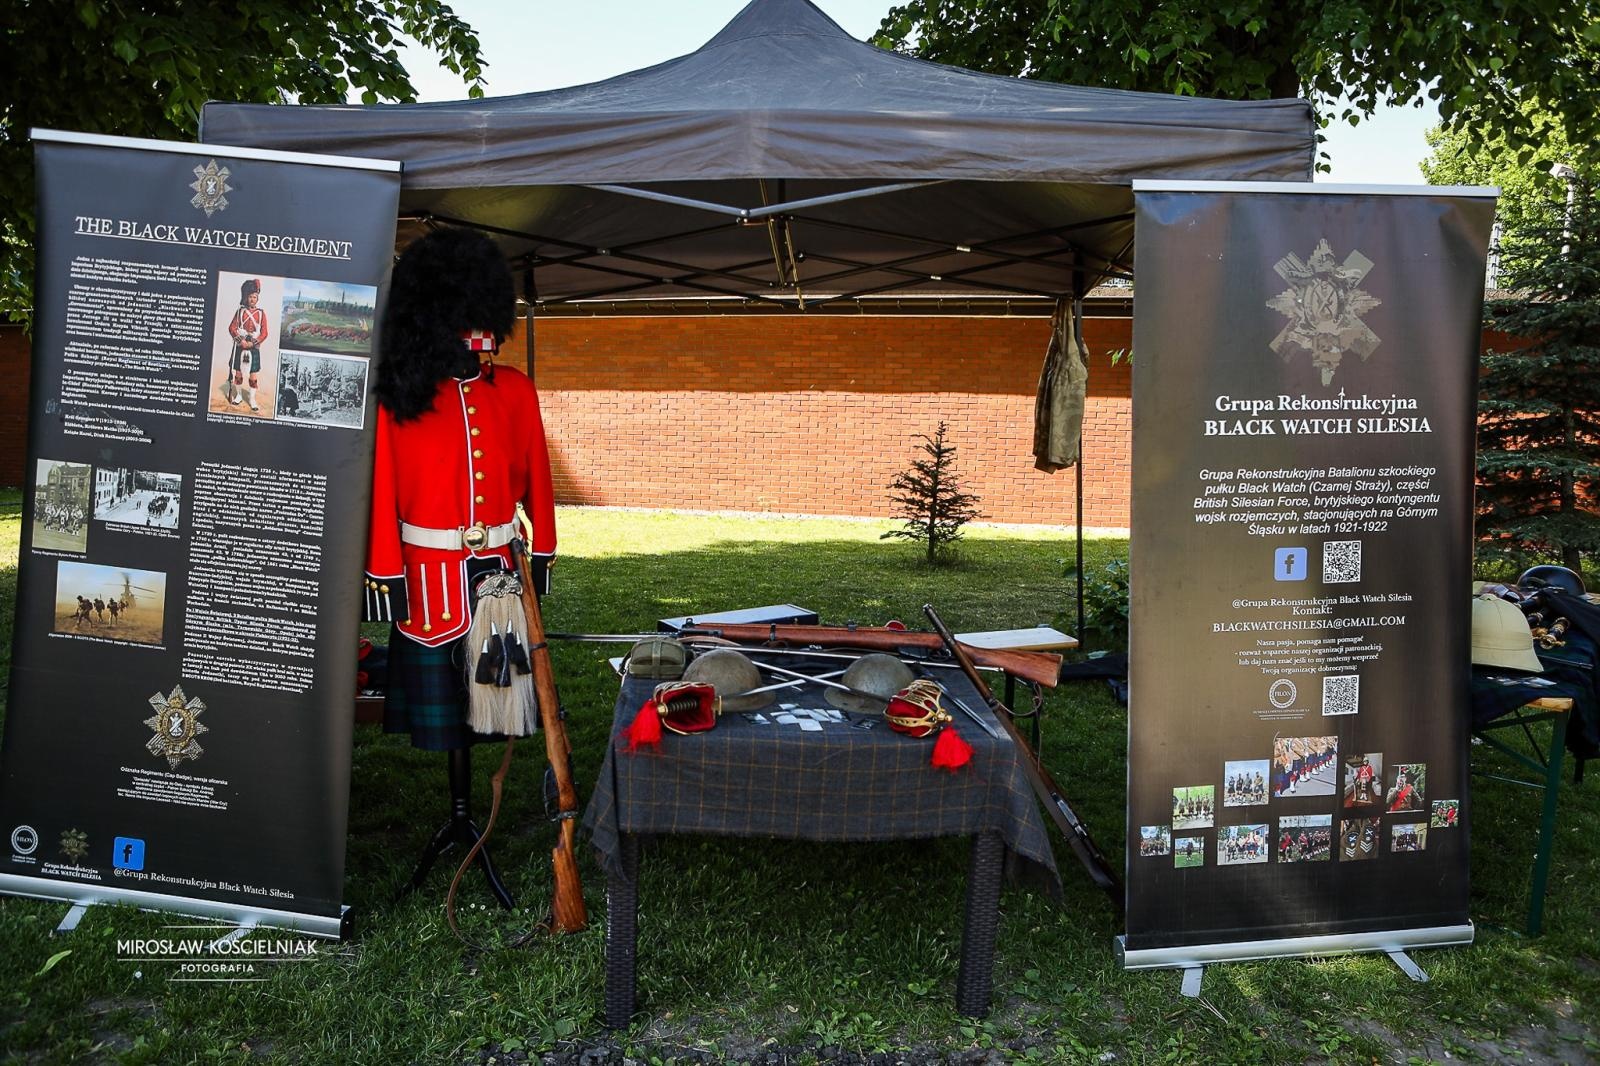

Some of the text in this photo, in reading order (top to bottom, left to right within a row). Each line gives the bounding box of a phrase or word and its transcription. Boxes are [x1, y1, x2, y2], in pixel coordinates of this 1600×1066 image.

[75, 216, 352, 257] THE BLACK WATCH REGIMENT
[1216, 391, 1417, 415] Grupa Rekonstrukcyjna
[1204, 417, 1432, 436] BLACK WATCH SILESIA
[1200, 466, 1436, 482] Grupa Rekonstrukcyjna Batalionu szkockiego
[1206, 483, 1235, 496] pułku
[1238, 482, 1268, 493] Black
[1272, 481, 1306, 493] Watch
[1355, 480, 1392, 493] Straży),
[1396, 479, 1430, 492] części
[1194, 493, 1440, 508] British Silesian Force, brytyjskiego kontyngentu
[1195, 507, 1438, 523] wojsk rozjemczych, stacjonujących na Górnym
[1248, 521, 1388, 537] Śląsku w latach 1921-1922
[1232, 599, 1268, 609] @Grupa
[1270, 597, 1337, 607] Rekonstrukcyjna
[1340, 596, 1360, 604] Black
[1293, 606, 1332, 615] Kontakt:
[1213, 616, 1406, 632] BLACKWATCHSILESIA@GMAIL.COM
[114, 868, 294, 899] @Grupa Rekonstrukcyjna Black Watch Silesia
